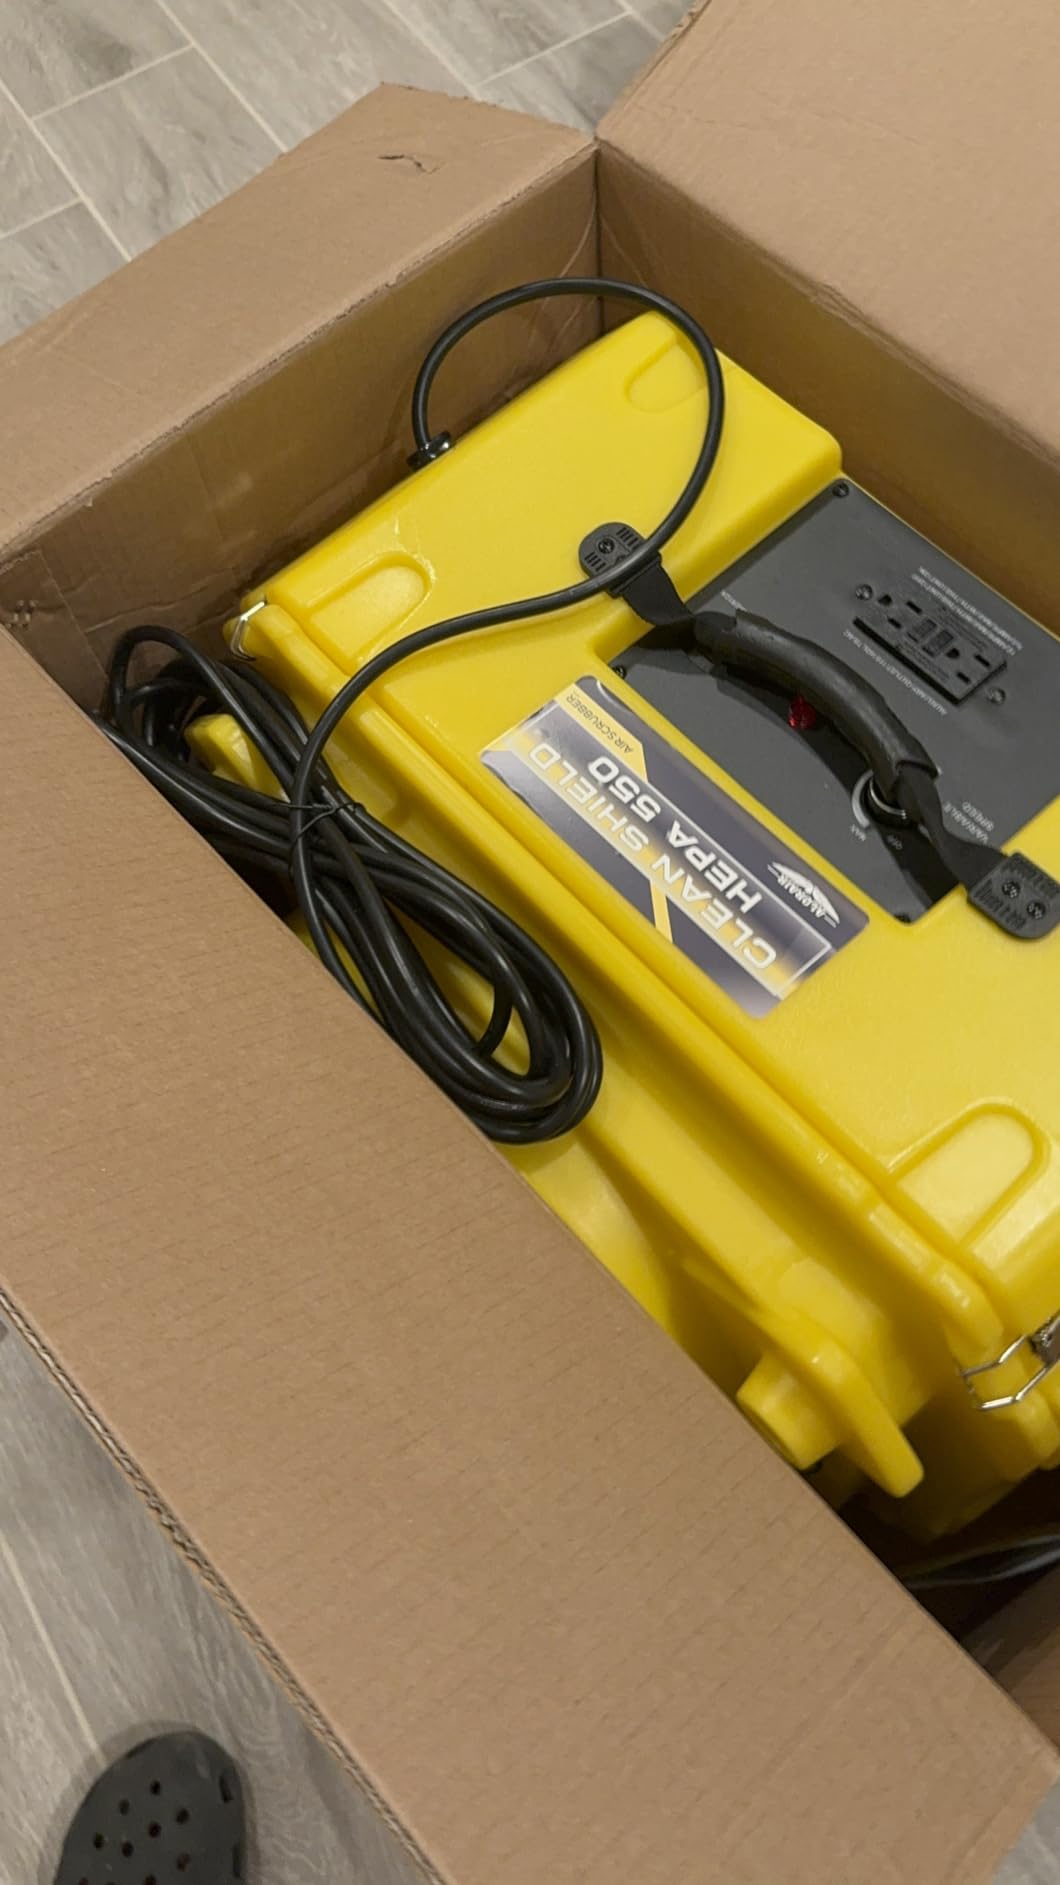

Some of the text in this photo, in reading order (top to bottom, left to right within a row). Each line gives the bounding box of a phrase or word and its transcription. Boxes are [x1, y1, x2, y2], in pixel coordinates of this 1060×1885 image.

[566, 693, 633, 754] AIR SCRUBBER
[530, 743, 777, 969] CLEAN SHIELD
[588, 756, 762, 914] HEPA 550
